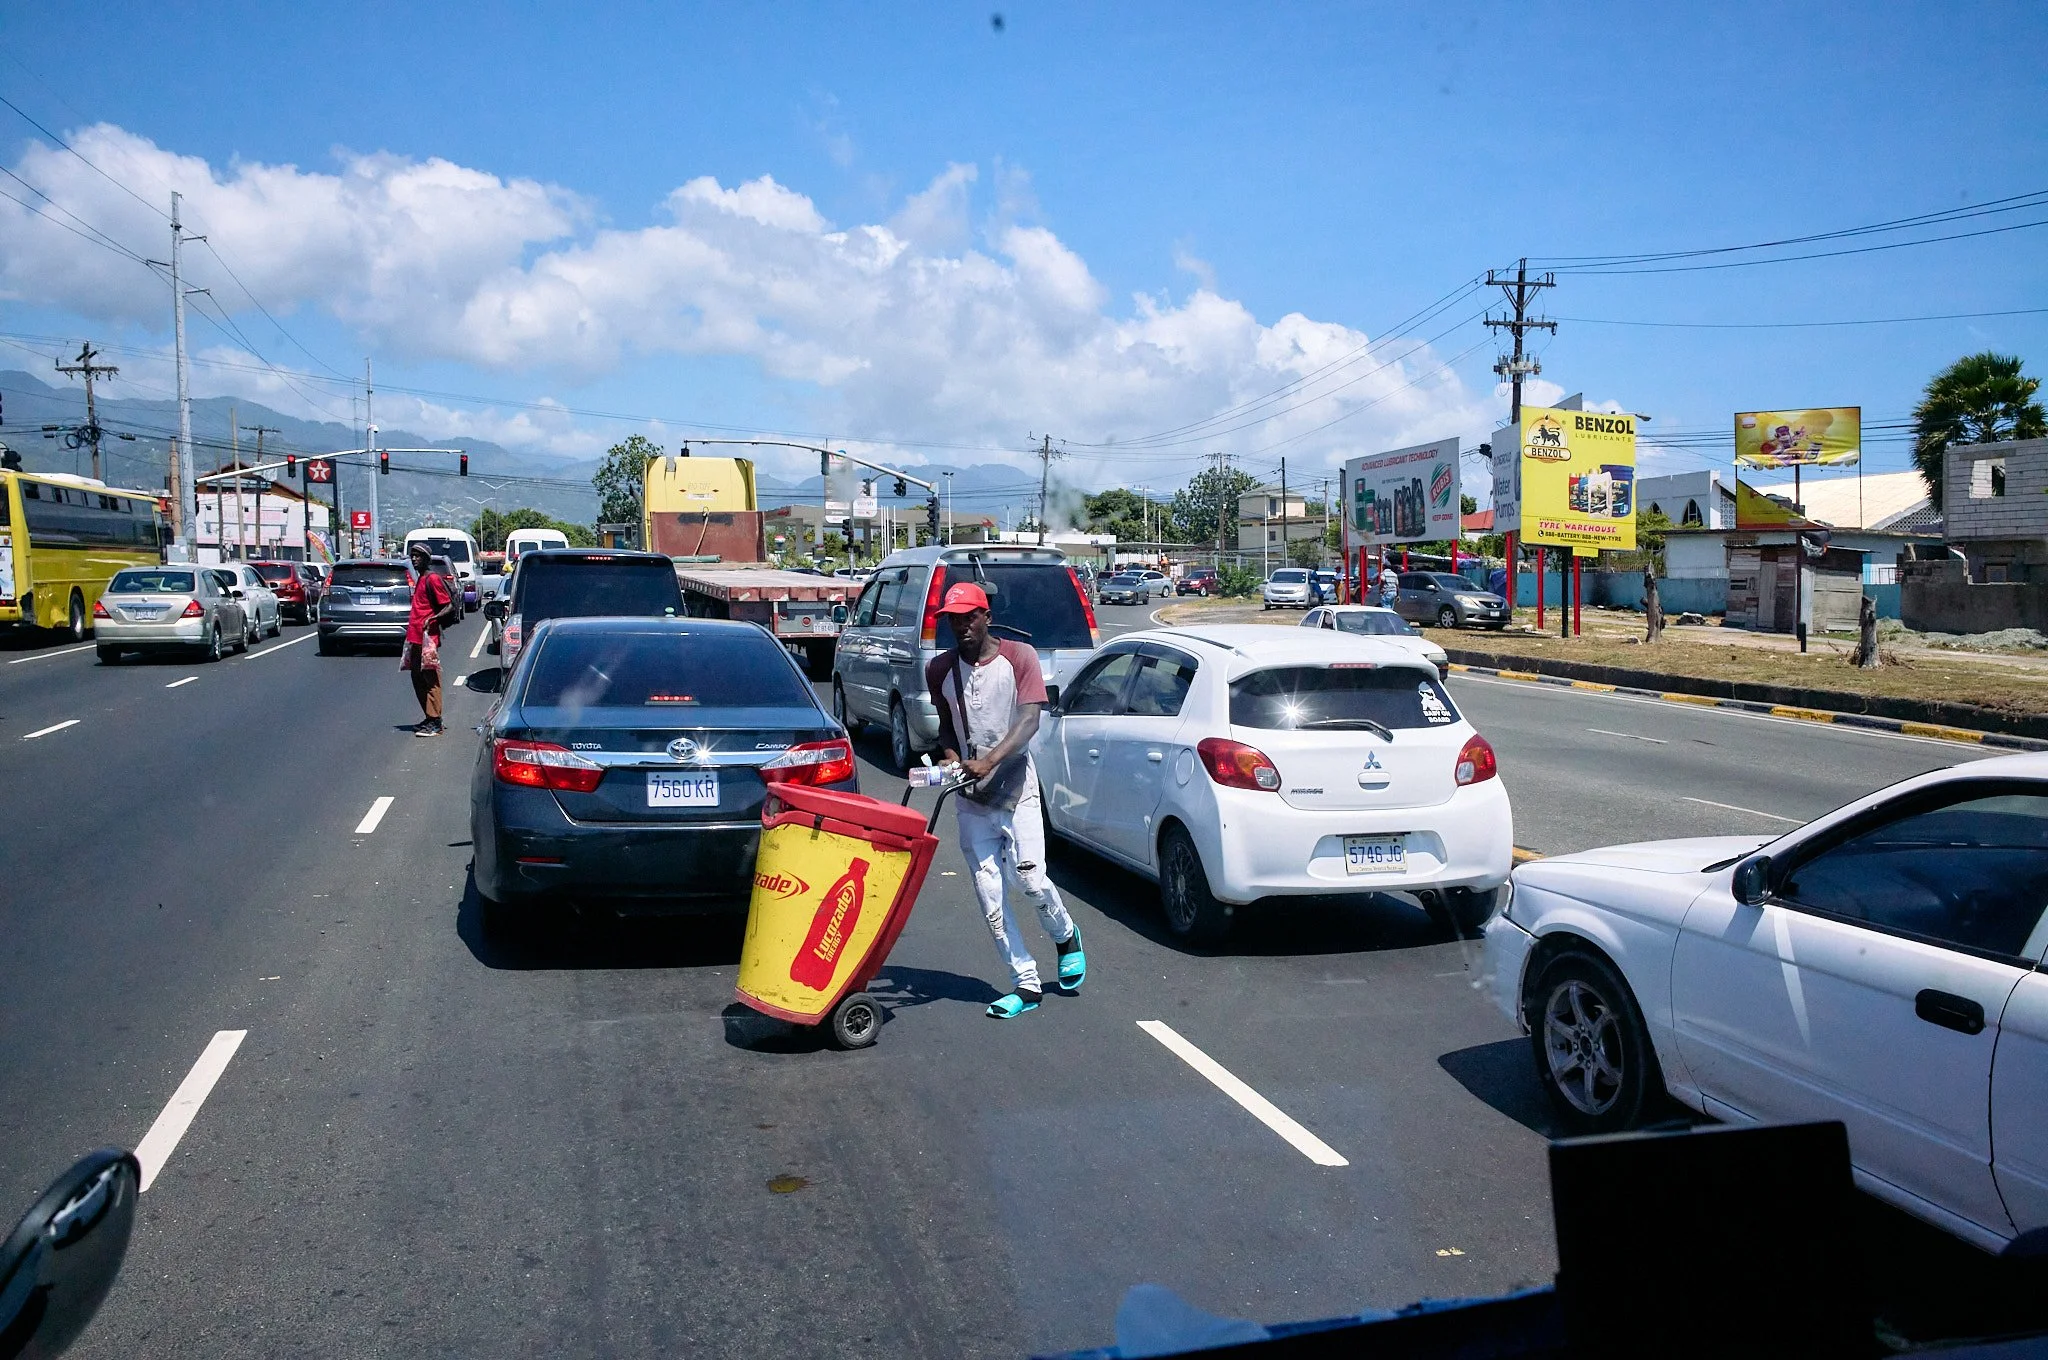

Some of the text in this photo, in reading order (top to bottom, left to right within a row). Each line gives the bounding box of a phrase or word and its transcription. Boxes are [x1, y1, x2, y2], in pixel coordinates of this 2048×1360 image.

[1575, 416, 1634, 435] BENZOL
[1531, 447, 1564, 459] BENZOL
[1432, 472, 1450, 499] RUBIS
[1539, 521, 1617, 533] TYRE WAREHOUSE
[651, 779, 715, 798] 7560 KR
[1349, 845, 1402, 864] 5746 JG
[813, 889, 853, 960] Lucozade
[825, 931, 842, 963] ENERGY
